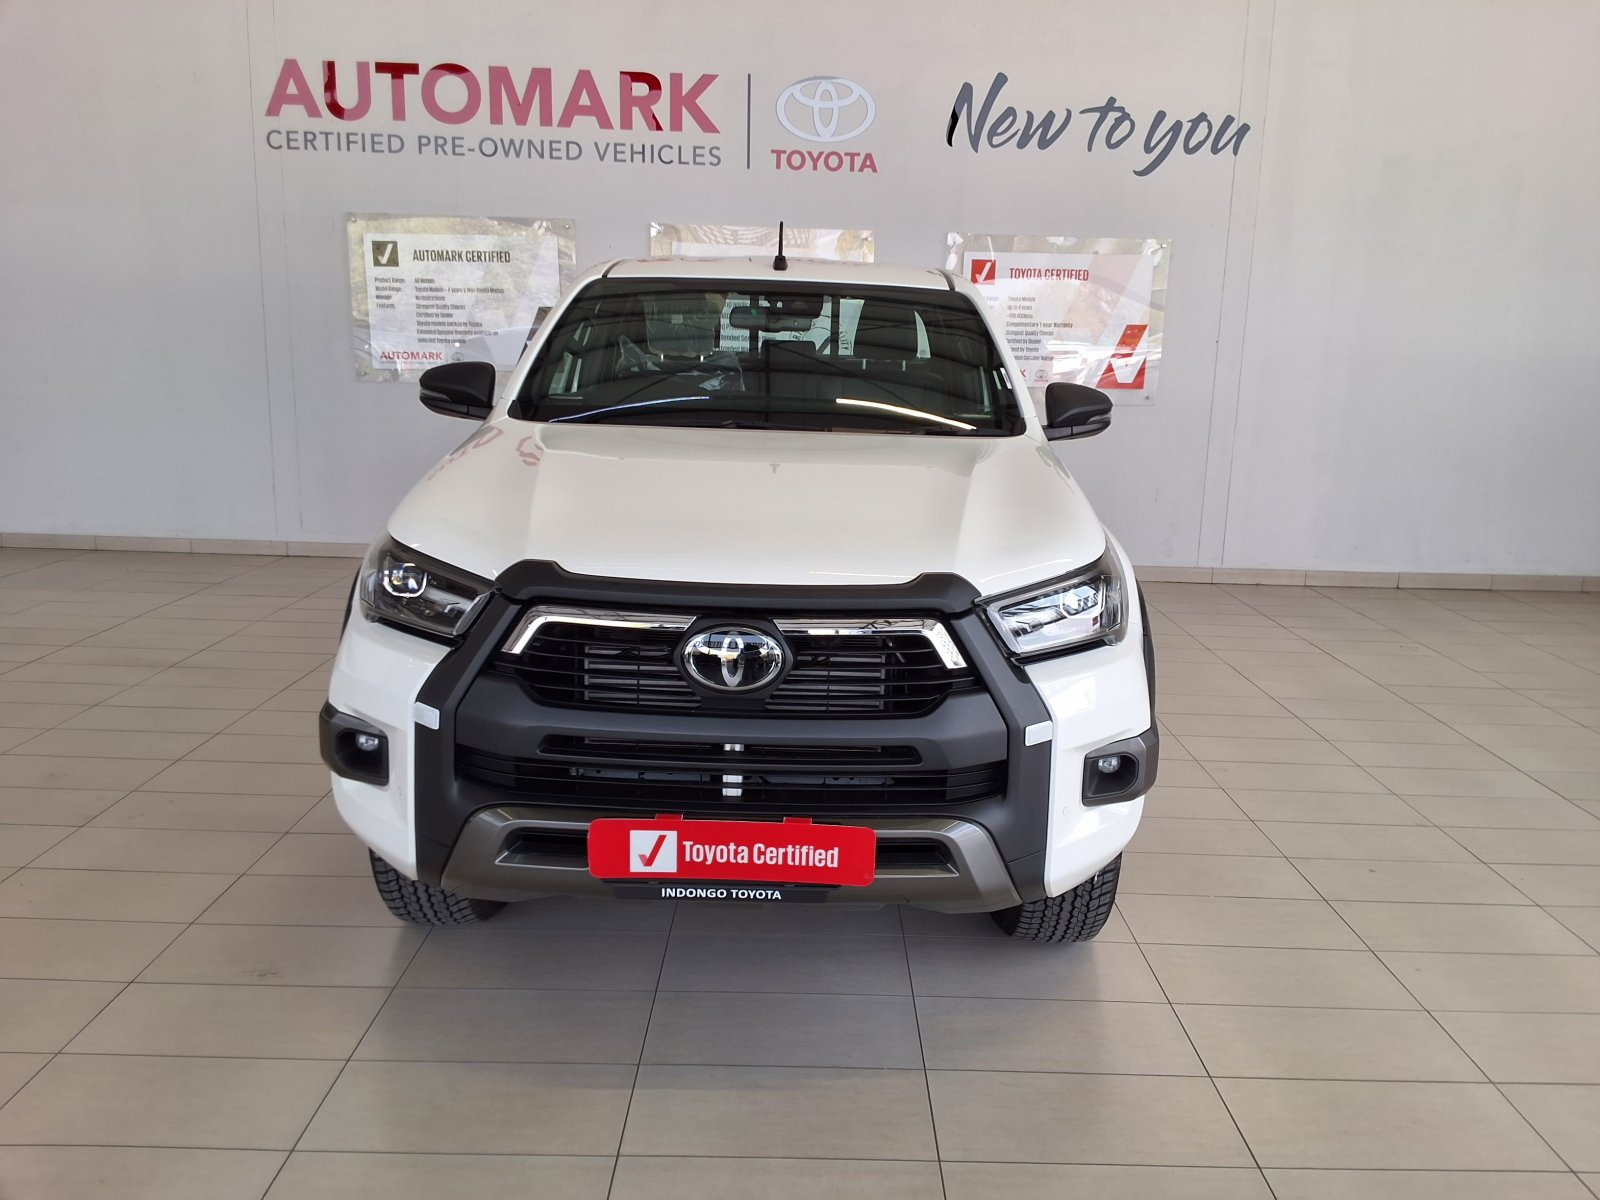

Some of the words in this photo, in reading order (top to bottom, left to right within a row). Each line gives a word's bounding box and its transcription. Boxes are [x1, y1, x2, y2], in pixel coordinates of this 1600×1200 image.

[265, 59, 720, 134] AUTOMARK
[946, 72, 1072, 153] New
[1079, 96, 1135, 152] to
[1133, 110, 1251, 177] you
[266, 129, 405, 155] CERTIFIED
[417, 135, 583, 162] PRE-OWNED
[594, 142, 722, 167] VEHICLES
[771, 149, 878, 173] TOYOTA
[412, 249, 464, 263] AUTOMARK
[465, 250, 511, 264] CERTIFIED
[1009, 267, 1042, 281] TOYOTA
[1044, 268, 1089, 281] CERTIFIED
[380, 350, 443, 360] AUTOMARK
[682, 840, 749, 865] Toyota
[753, 843, 839, 868] Certified
[661, 887, 727, 898] INDONGO
[731, 889, 782, 900] TOYOTA
